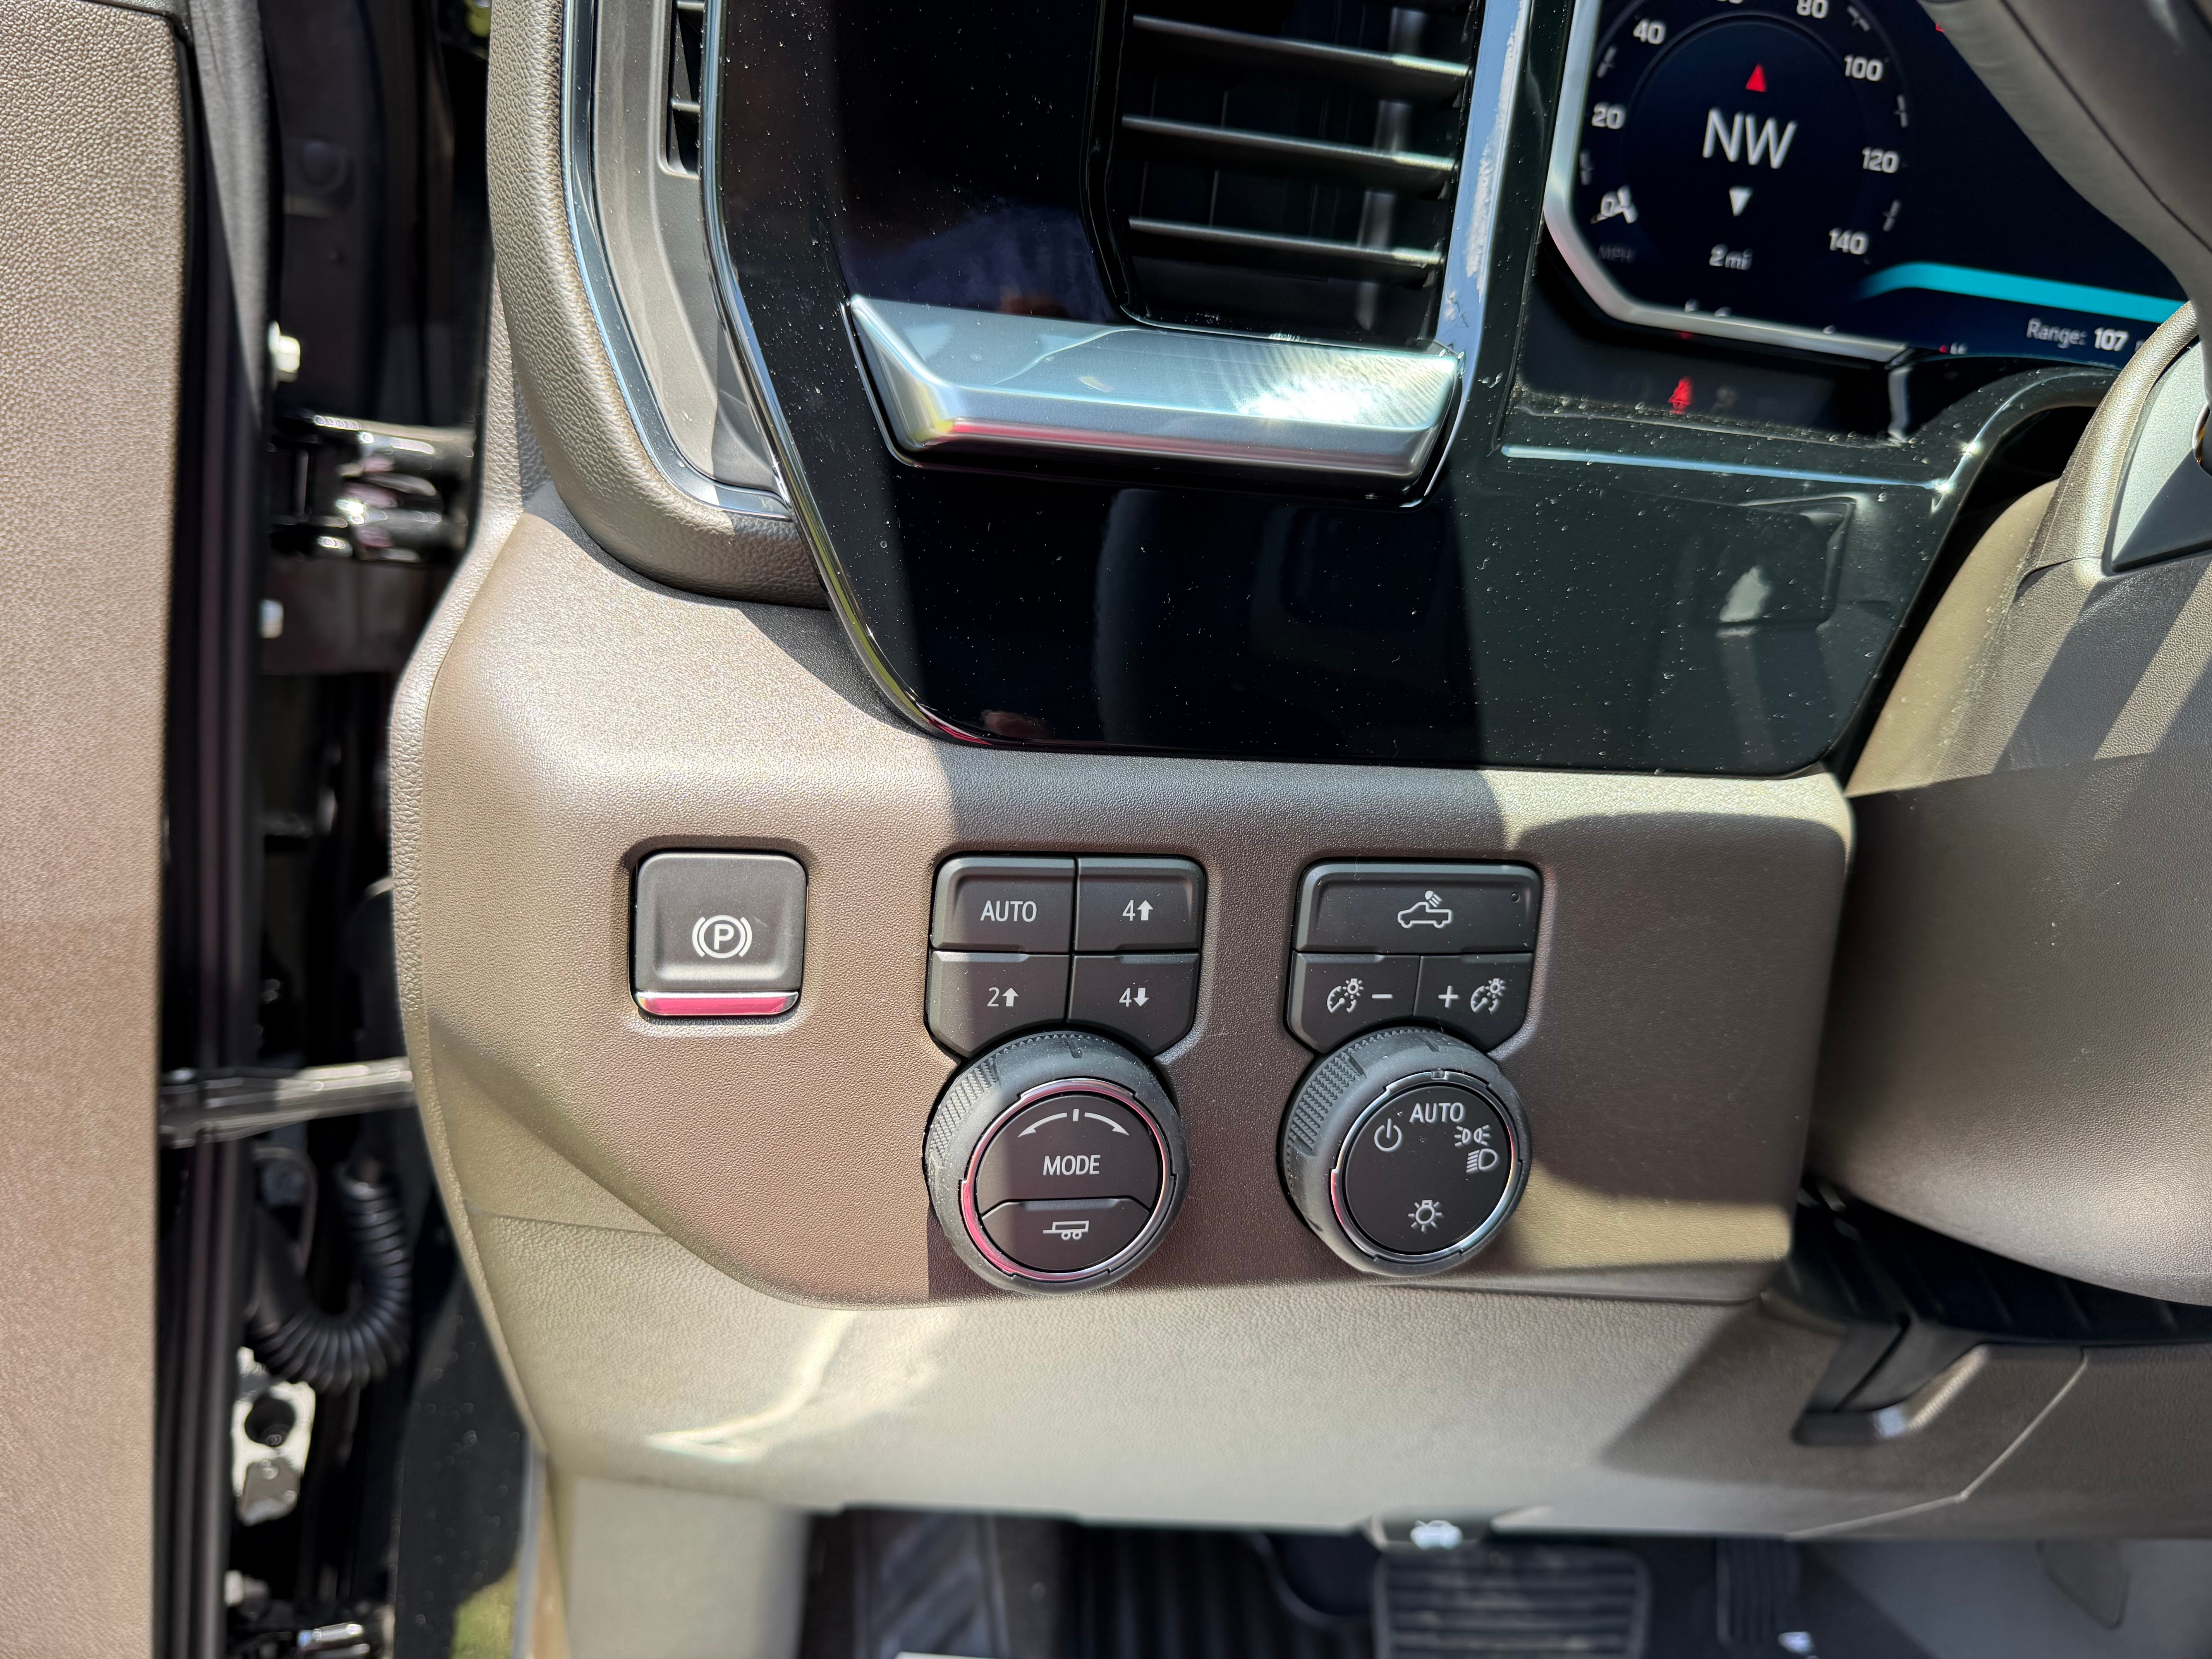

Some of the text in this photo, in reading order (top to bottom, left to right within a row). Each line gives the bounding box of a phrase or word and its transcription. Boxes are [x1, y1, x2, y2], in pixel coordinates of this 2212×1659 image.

[1633, 19, 1666, 45] 40
[1844, 54, 1883, 81] 100
[1591, 102, 1626, 129] 20
[1703, 107, 1798, 168] NW
[1862, 147, 1899, 173] 120
[1829, 228, 1868, 254] 140
[2027, 318, 2087, 349] Range:
[2094, 327, 2129, 351] 107
[980, 900, 1037, 922] AUTO
[714, 924, 734, 950] P
[1409, 1102, 1465, 1123] AUTO
[1043, 1155, 1101, 1175] MODE
